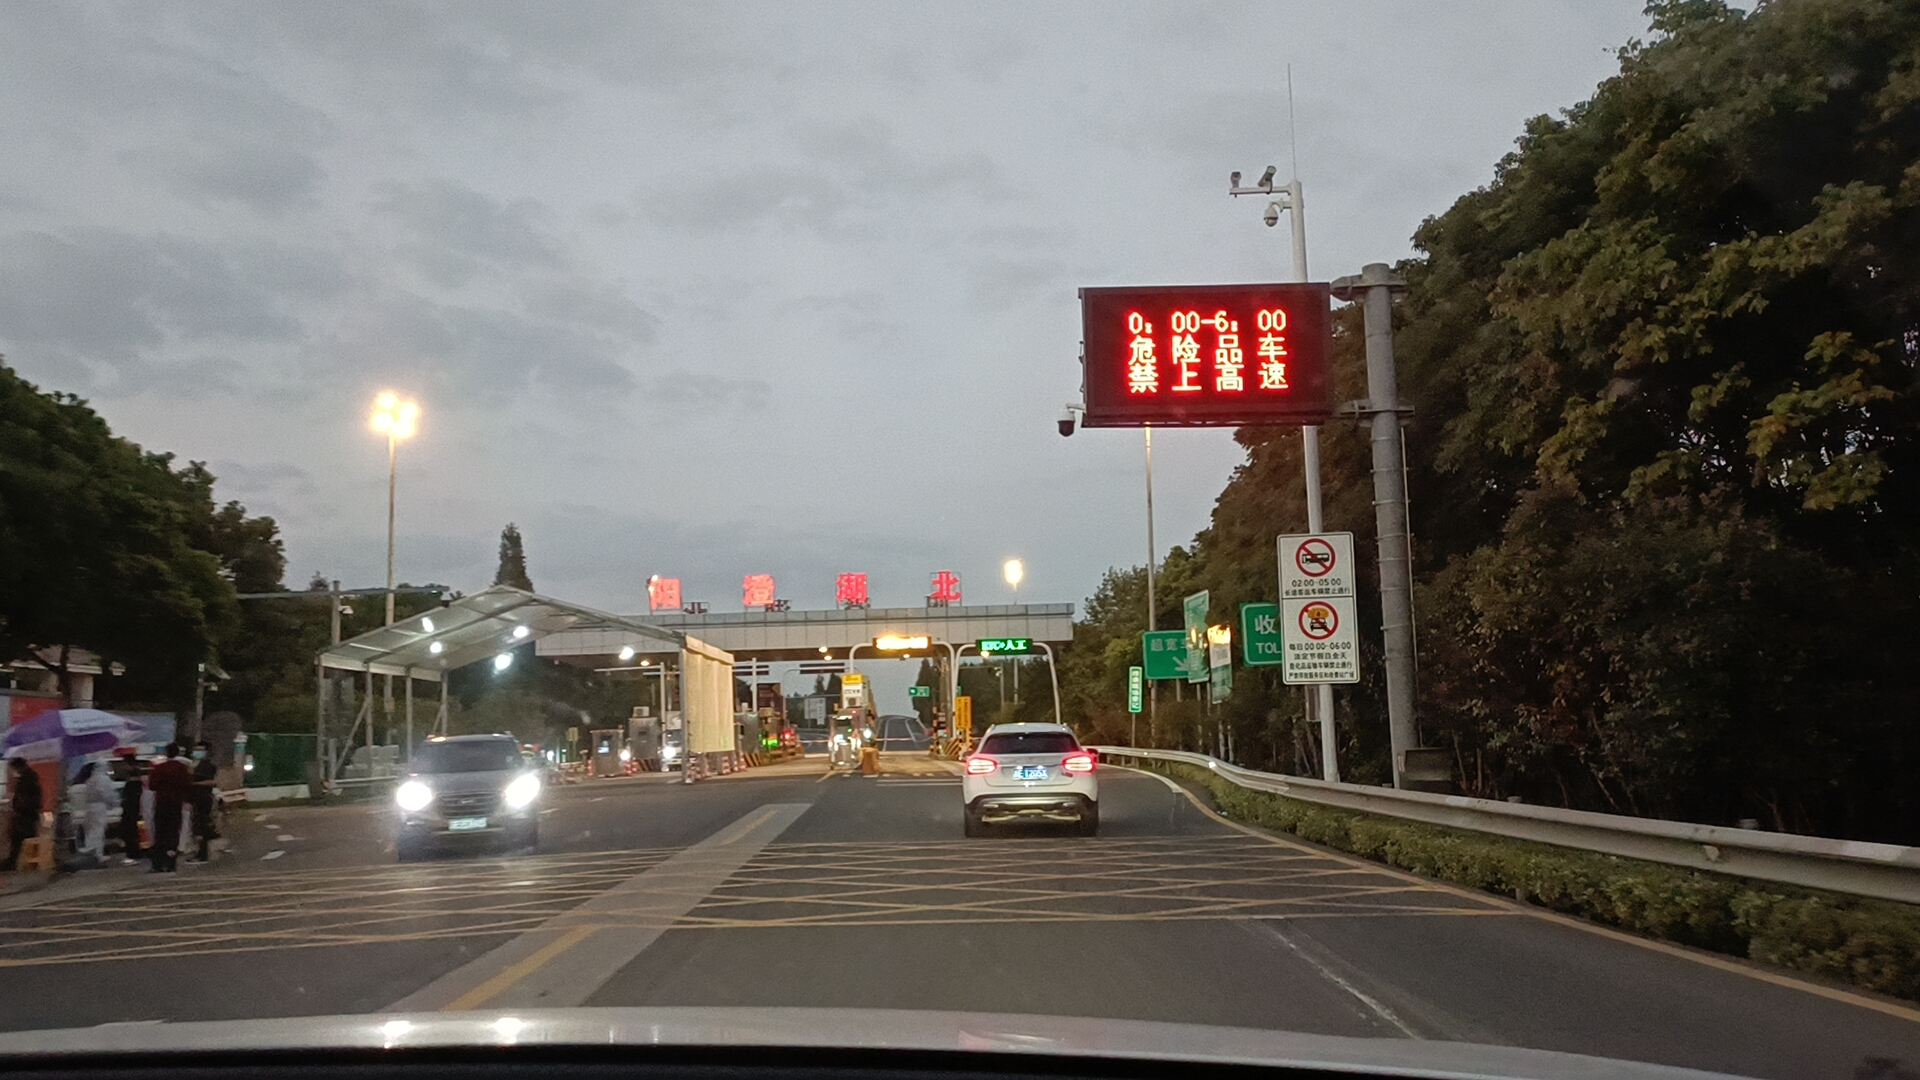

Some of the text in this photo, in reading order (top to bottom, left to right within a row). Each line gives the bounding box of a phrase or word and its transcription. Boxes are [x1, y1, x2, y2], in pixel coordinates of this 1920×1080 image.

[1128, 333, 1288, 365] 危险品车
[1128, 361, 1289, 393] 禁上高速
[648, 570, 963, 610] 阳澄湖北
[1254, 614, 1277, 635] 收
